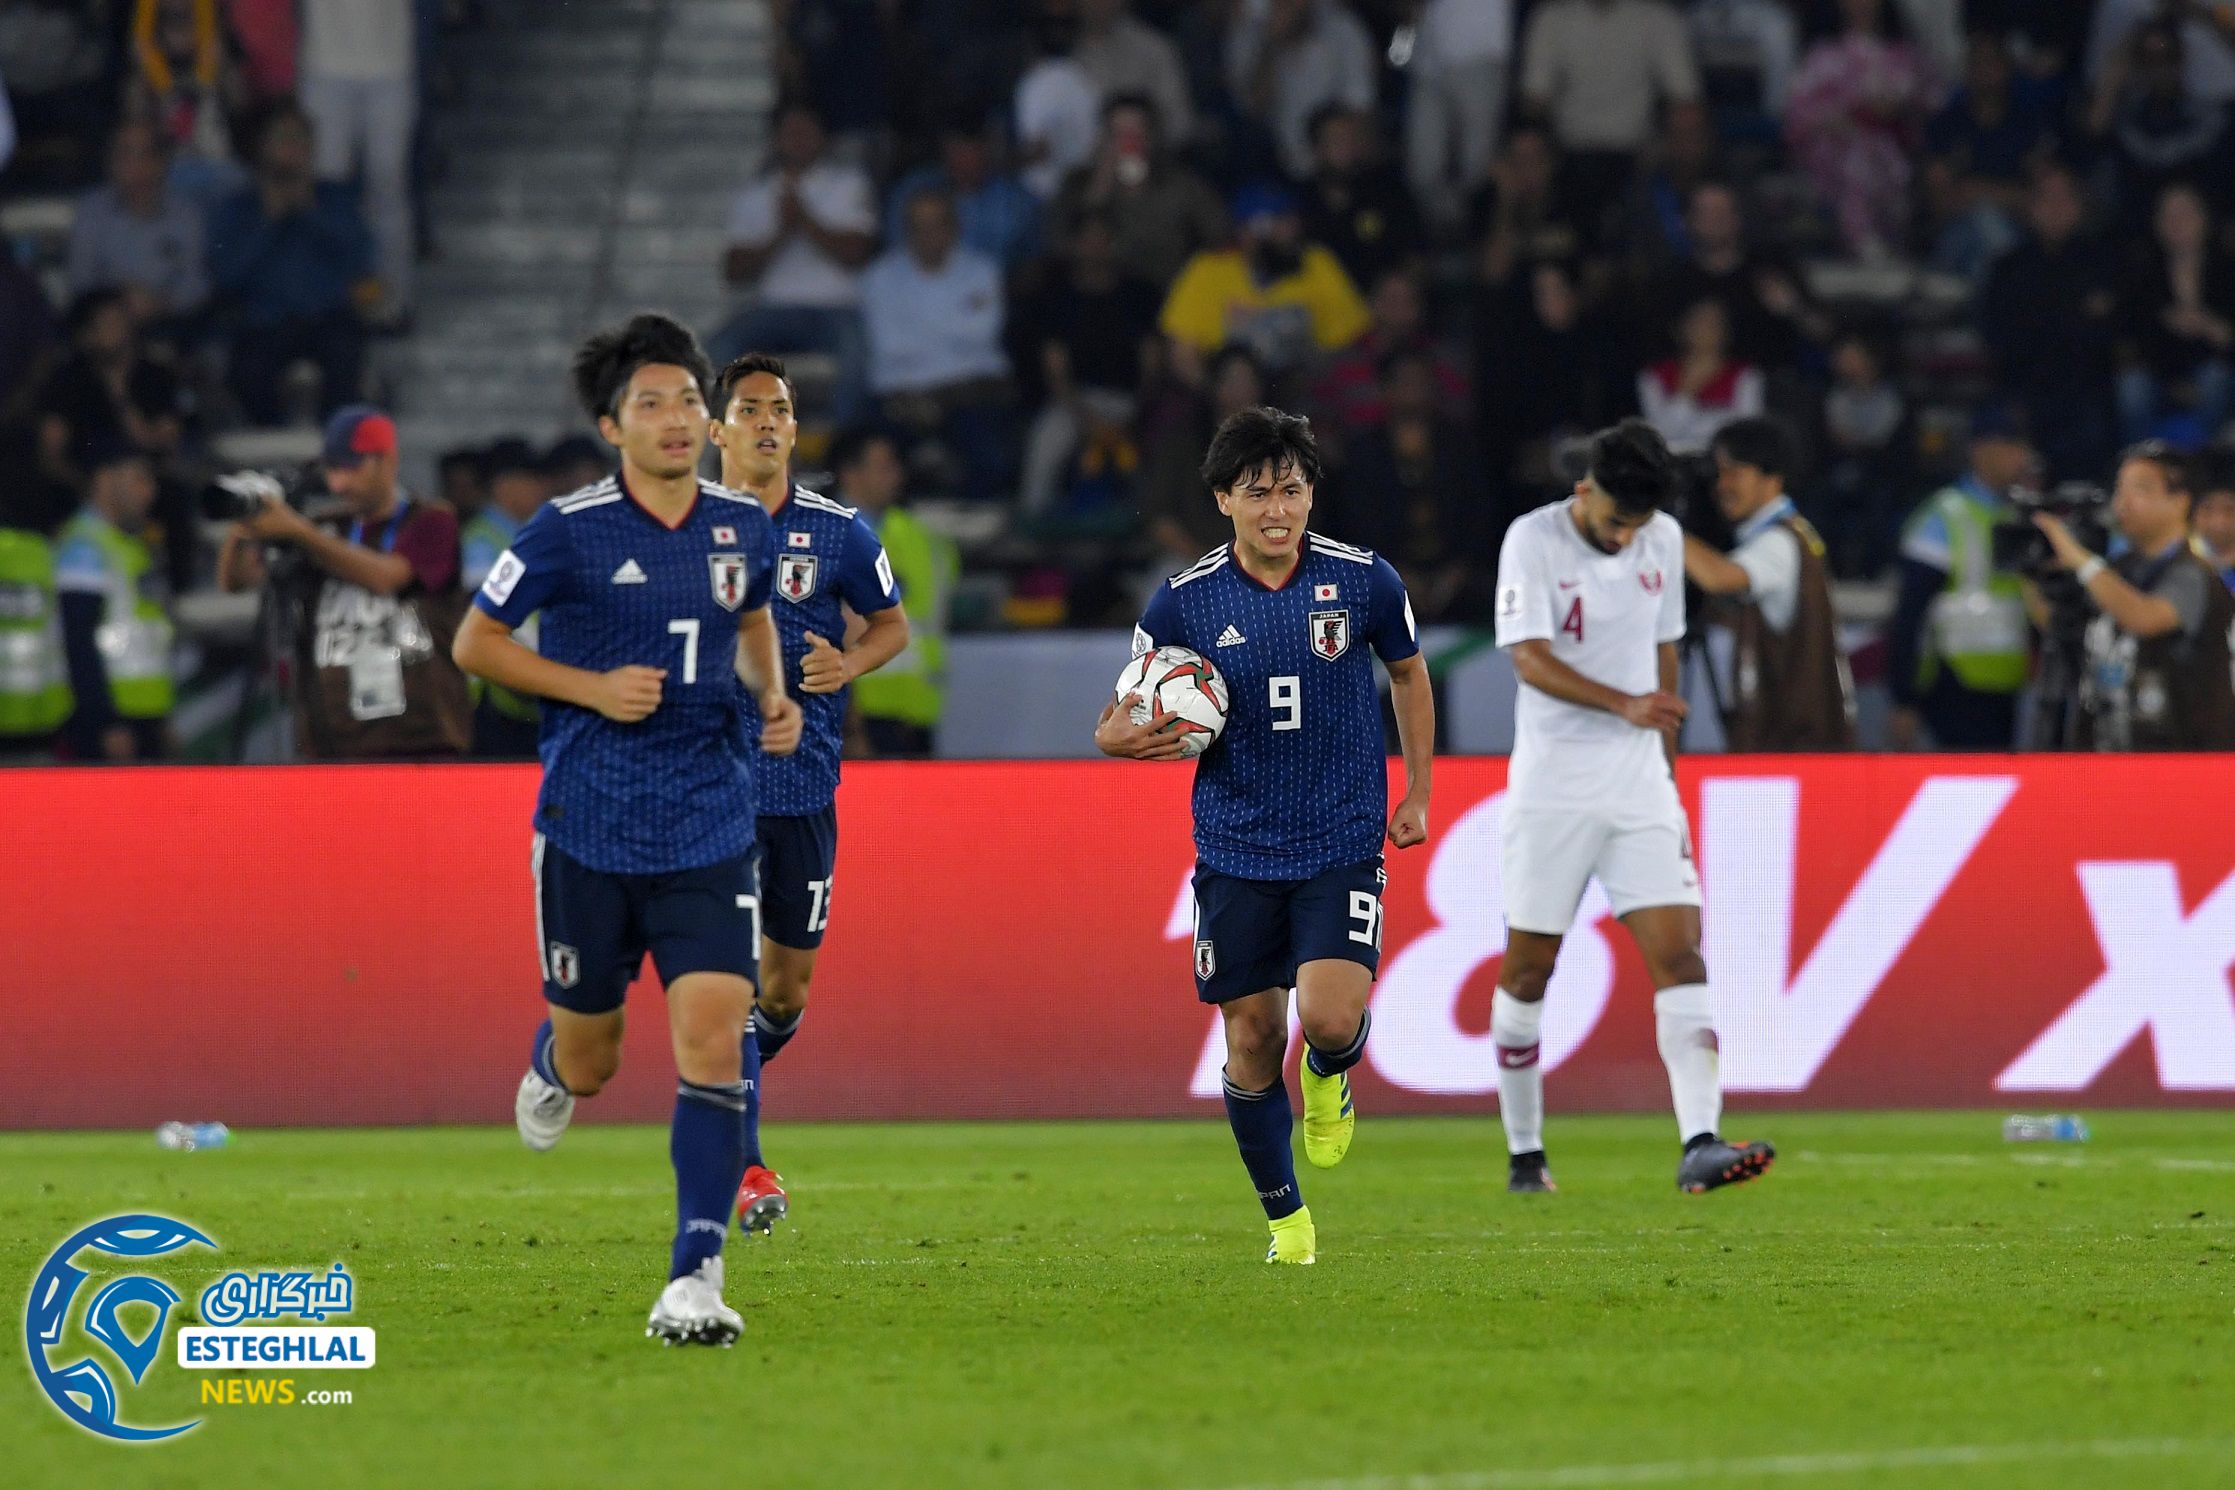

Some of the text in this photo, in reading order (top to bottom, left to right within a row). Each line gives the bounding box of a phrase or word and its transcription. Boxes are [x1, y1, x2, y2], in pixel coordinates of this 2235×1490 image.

[1216, 636, 1246, 647] adidas
[1561, 595, 1584, 644] 4
[668, 619, 700, 684] 7
[1269, 676, 1301, 731] 9
[735, 894, 761, 961] 7
[1349, 890, 1377, 946] 9
